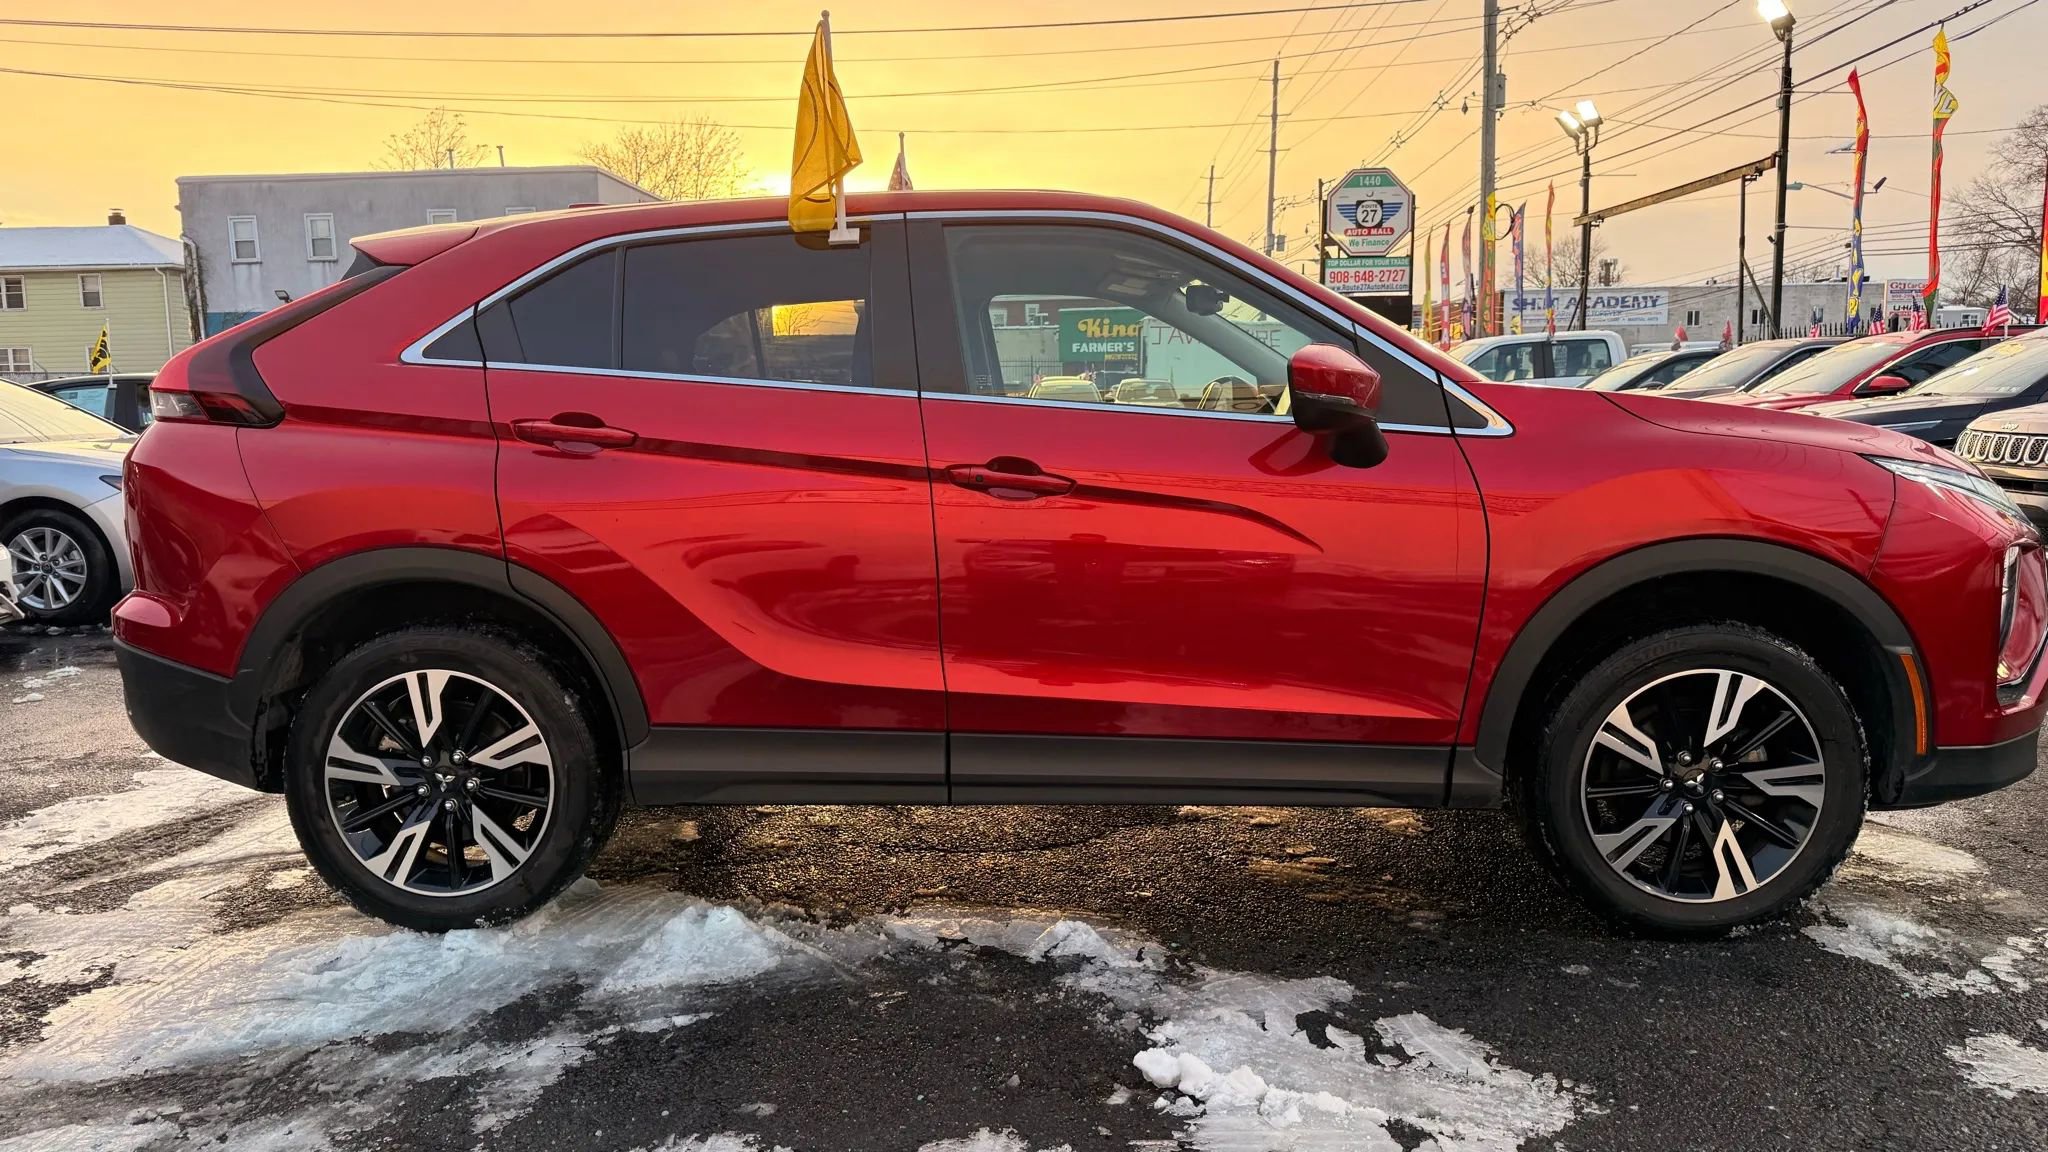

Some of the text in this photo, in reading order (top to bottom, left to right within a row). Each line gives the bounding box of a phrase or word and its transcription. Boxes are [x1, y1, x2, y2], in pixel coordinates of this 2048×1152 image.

[1359, 176, 1381, 186] 1440
[1361, 209, 1378, 223] 27
[1349, 238, 1390, 247] We Finance
[1329, 269, 1406, 284] 908-648-2727
[1072, 341, 1135, 353] FARMER'S
